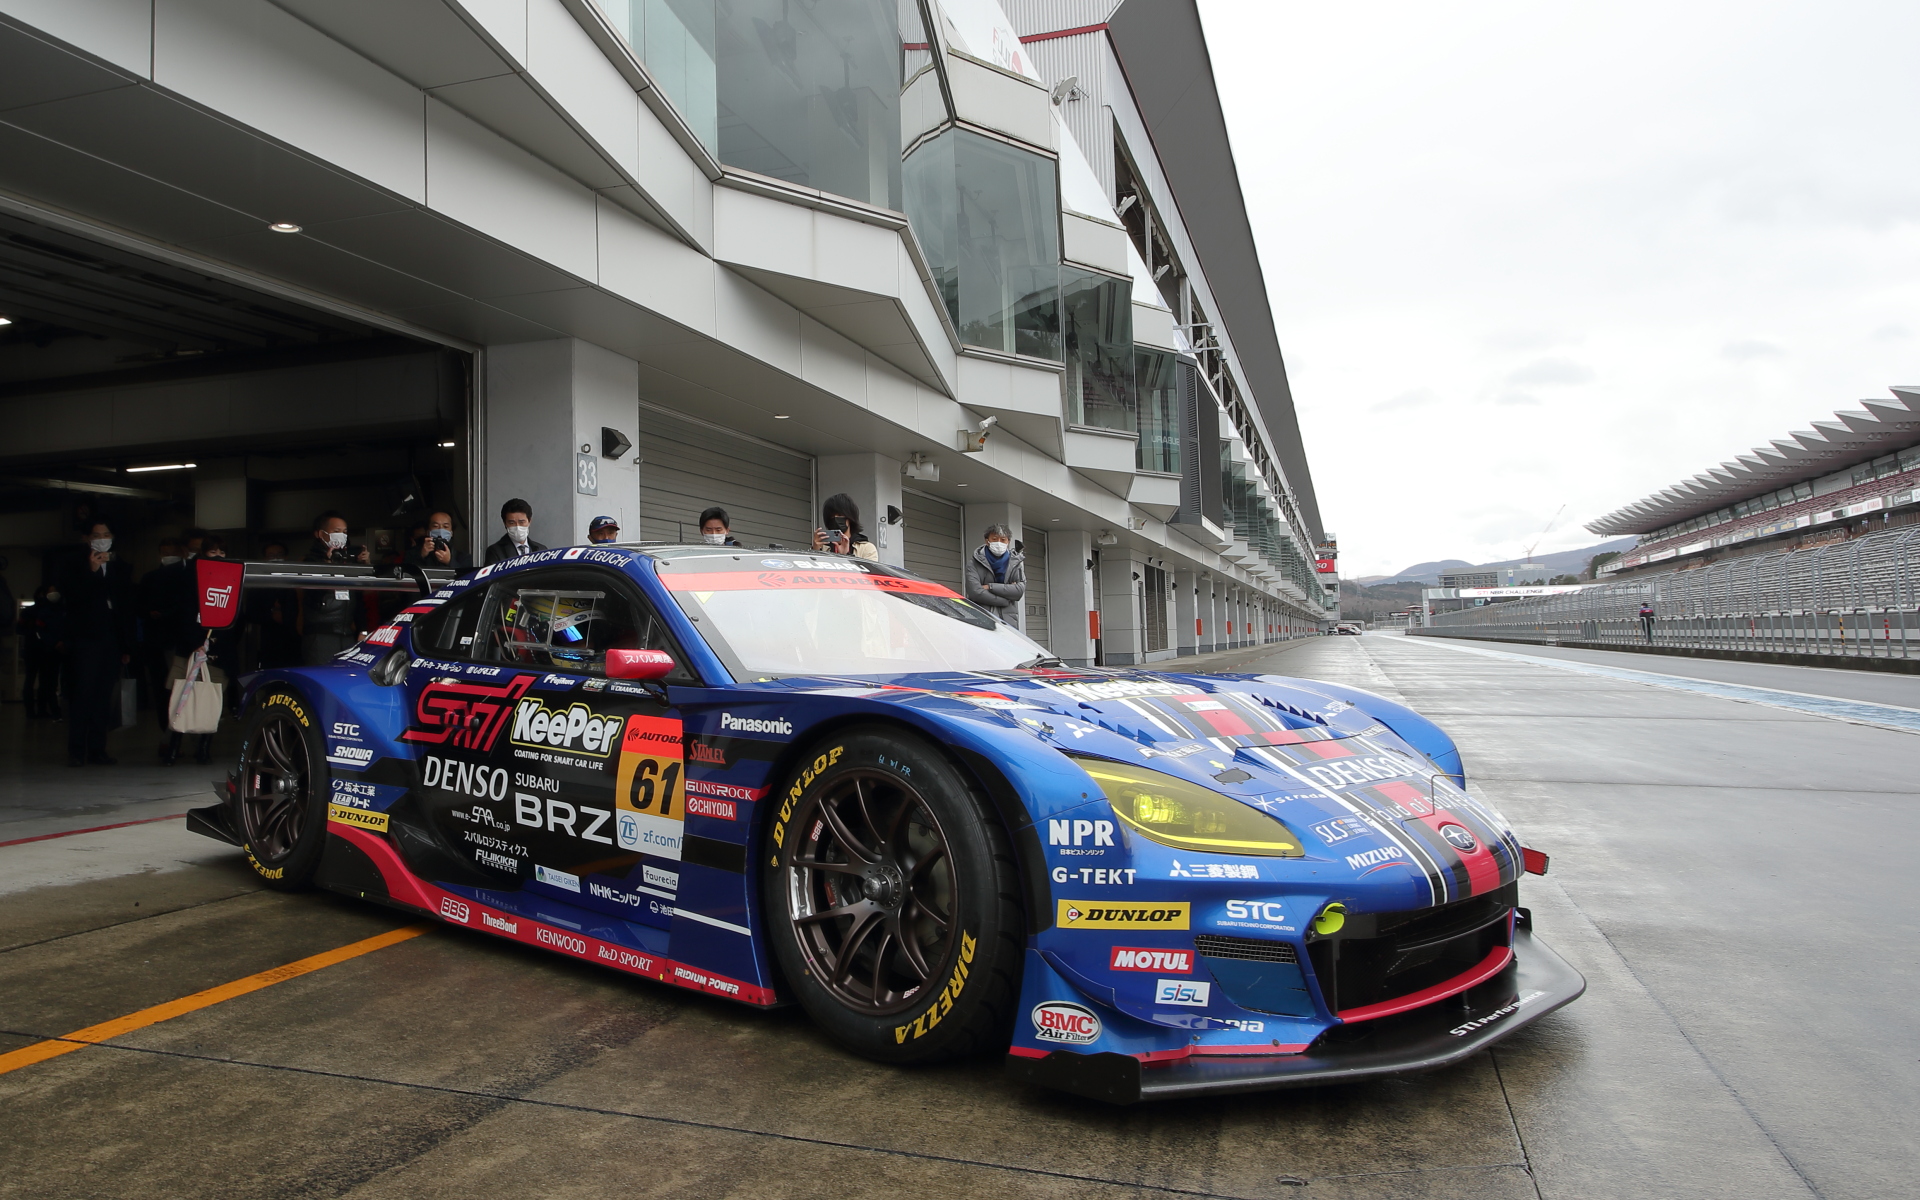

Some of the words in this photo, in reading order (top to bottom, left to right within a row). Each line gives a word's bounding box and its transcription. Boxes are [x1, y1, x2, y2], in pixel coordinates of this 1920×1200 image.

[579, 459, 597, 490] 33
[880, 526, 887, 545] 32
[494, 549, 562, 572] H.YAMAUCHI
[583, 549, 633, 568] T.IGUCHI
[793, 560, 870, 573] SUBARU
[792, 576, 910, 589] AUTOBACS
[268, 694, 310, 727] DUNLOP
[333, 722, 360, 736] STC
[513, 699, 622, 752] KeePer
[721, 712, 792, 735] Panasonic
[334, 745, 373, 760] SHOWA
[514, 749, 539, 760] COATING
[540, 753, 552, 762] FOR
[553, 756, 574, 766] SMART
[574, 759, 587, 768] CAR
[588, 761, 604, 771] LIFE
[423, 755, 508, 801] DENSO
[515, 772, 559, 793] SUBARU
[1307, 755, 1415, 790] DENSO
[344, 781, 375, 797] 坂本工業
[630, 758, 681, 816] 61
[773, 745, 844, 849] DUNLOP
[351, 796, 370, 808] リード
[697, 800, 733, 818] CHIYODA
[1275, 793, 1327, 804] Strada
[338, 811, 385, 826] DUNLOP
[515, 792, 612, 845] BRZ
[621, 821, 636, 839] ZF
[643, 830, 683, 849] zf.com/
[1049, 819, 1115, 846] NPR
[1315, 821, 1349, 843] SLS
[464, 830, 529, 858] スバルロジスティクス
[475, 848, 518, 868] FUJIKIKAI
[1345, 846, 1403, 870] MIZUHO
[548, 873, 563, 884] TAISEI
[564, 877, 580, 888] GIKEN
[645, 870, 676, 886] faurecia
[1052, 867, 1137, 885] G-TEKT
[1189, 864, 1259, 880] 三菱製鋼
[441, 897, 469, 923] BBS
[1085, 908, 1182, 922] DUNLOP
[1226, 900, 1285, 922] STC
[482, 911, 517, 934] ThreeBond
[1259, 923, 1295, 932] CORPORATION
[536, 927, 586, 954] KENWOOD
[598, 945, 618, 961] R&D
[619, 951, 653, 972] SPORT
[1114, 950, 1190, 970] MOTUL
[674, 967, 707, 985] IRIDIUM
[708, 977, 739, 995] POWER
[895, 929, 977, 1044] DIREZZA
[1040, 1009, 1093, 1034] BMC
[1450, 1021, 1482, 1037] STI
[1040, 1028, 1064, 1039] Air
[1065, 1032, 1090, 1041] Filter
